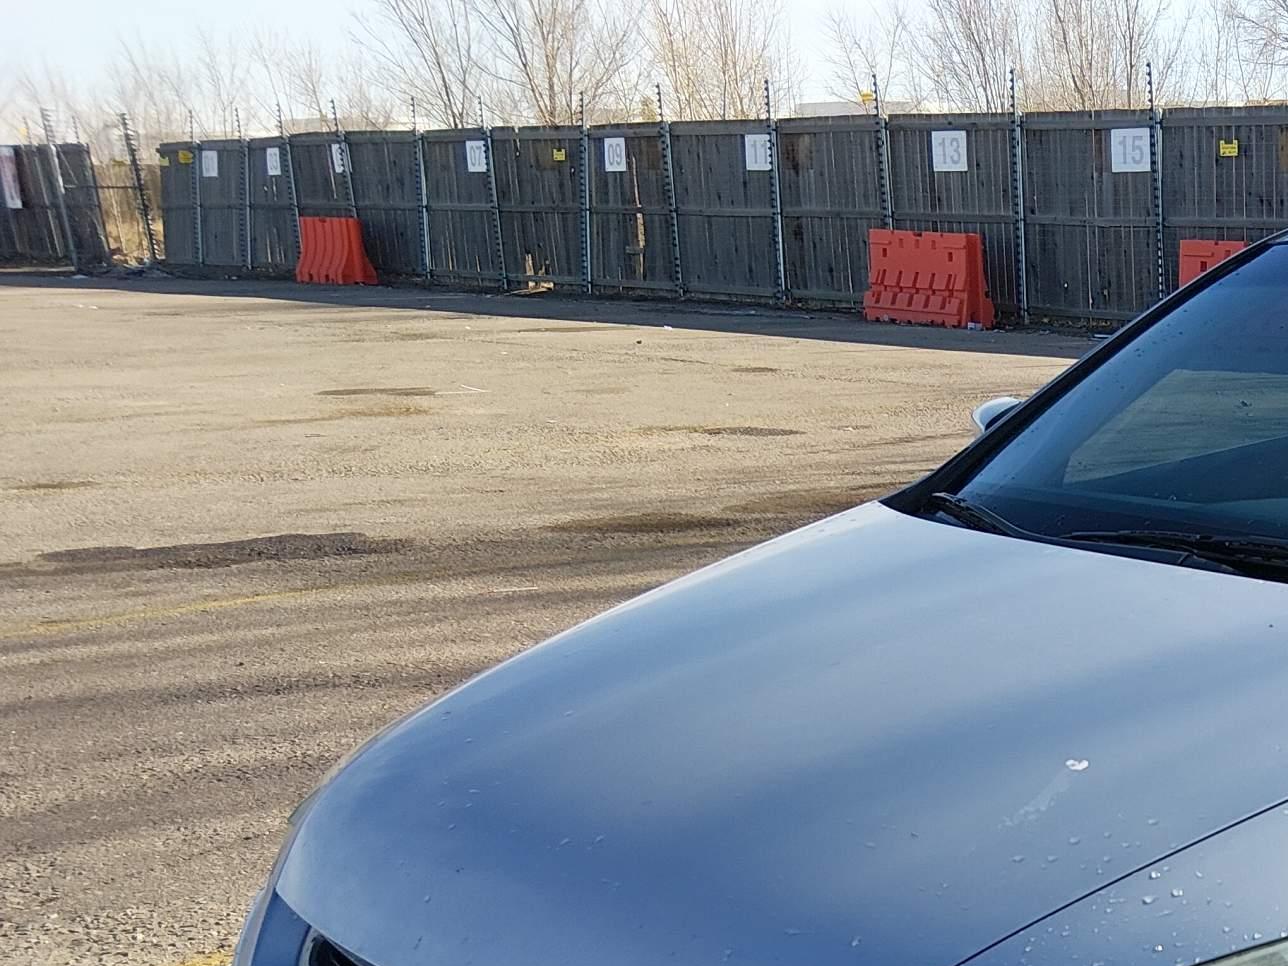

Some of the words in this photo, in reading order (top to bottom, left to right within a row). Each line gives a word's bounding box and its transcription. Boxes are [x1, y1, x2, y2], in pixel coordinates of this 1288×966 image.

[470, 145, 483, 168] 07
[607, 143, 623, 166] 09
[751, 140, 768, 165] 11
[938, 137, 960, 166] 13
[1119, 135, 1145, 165] 15
